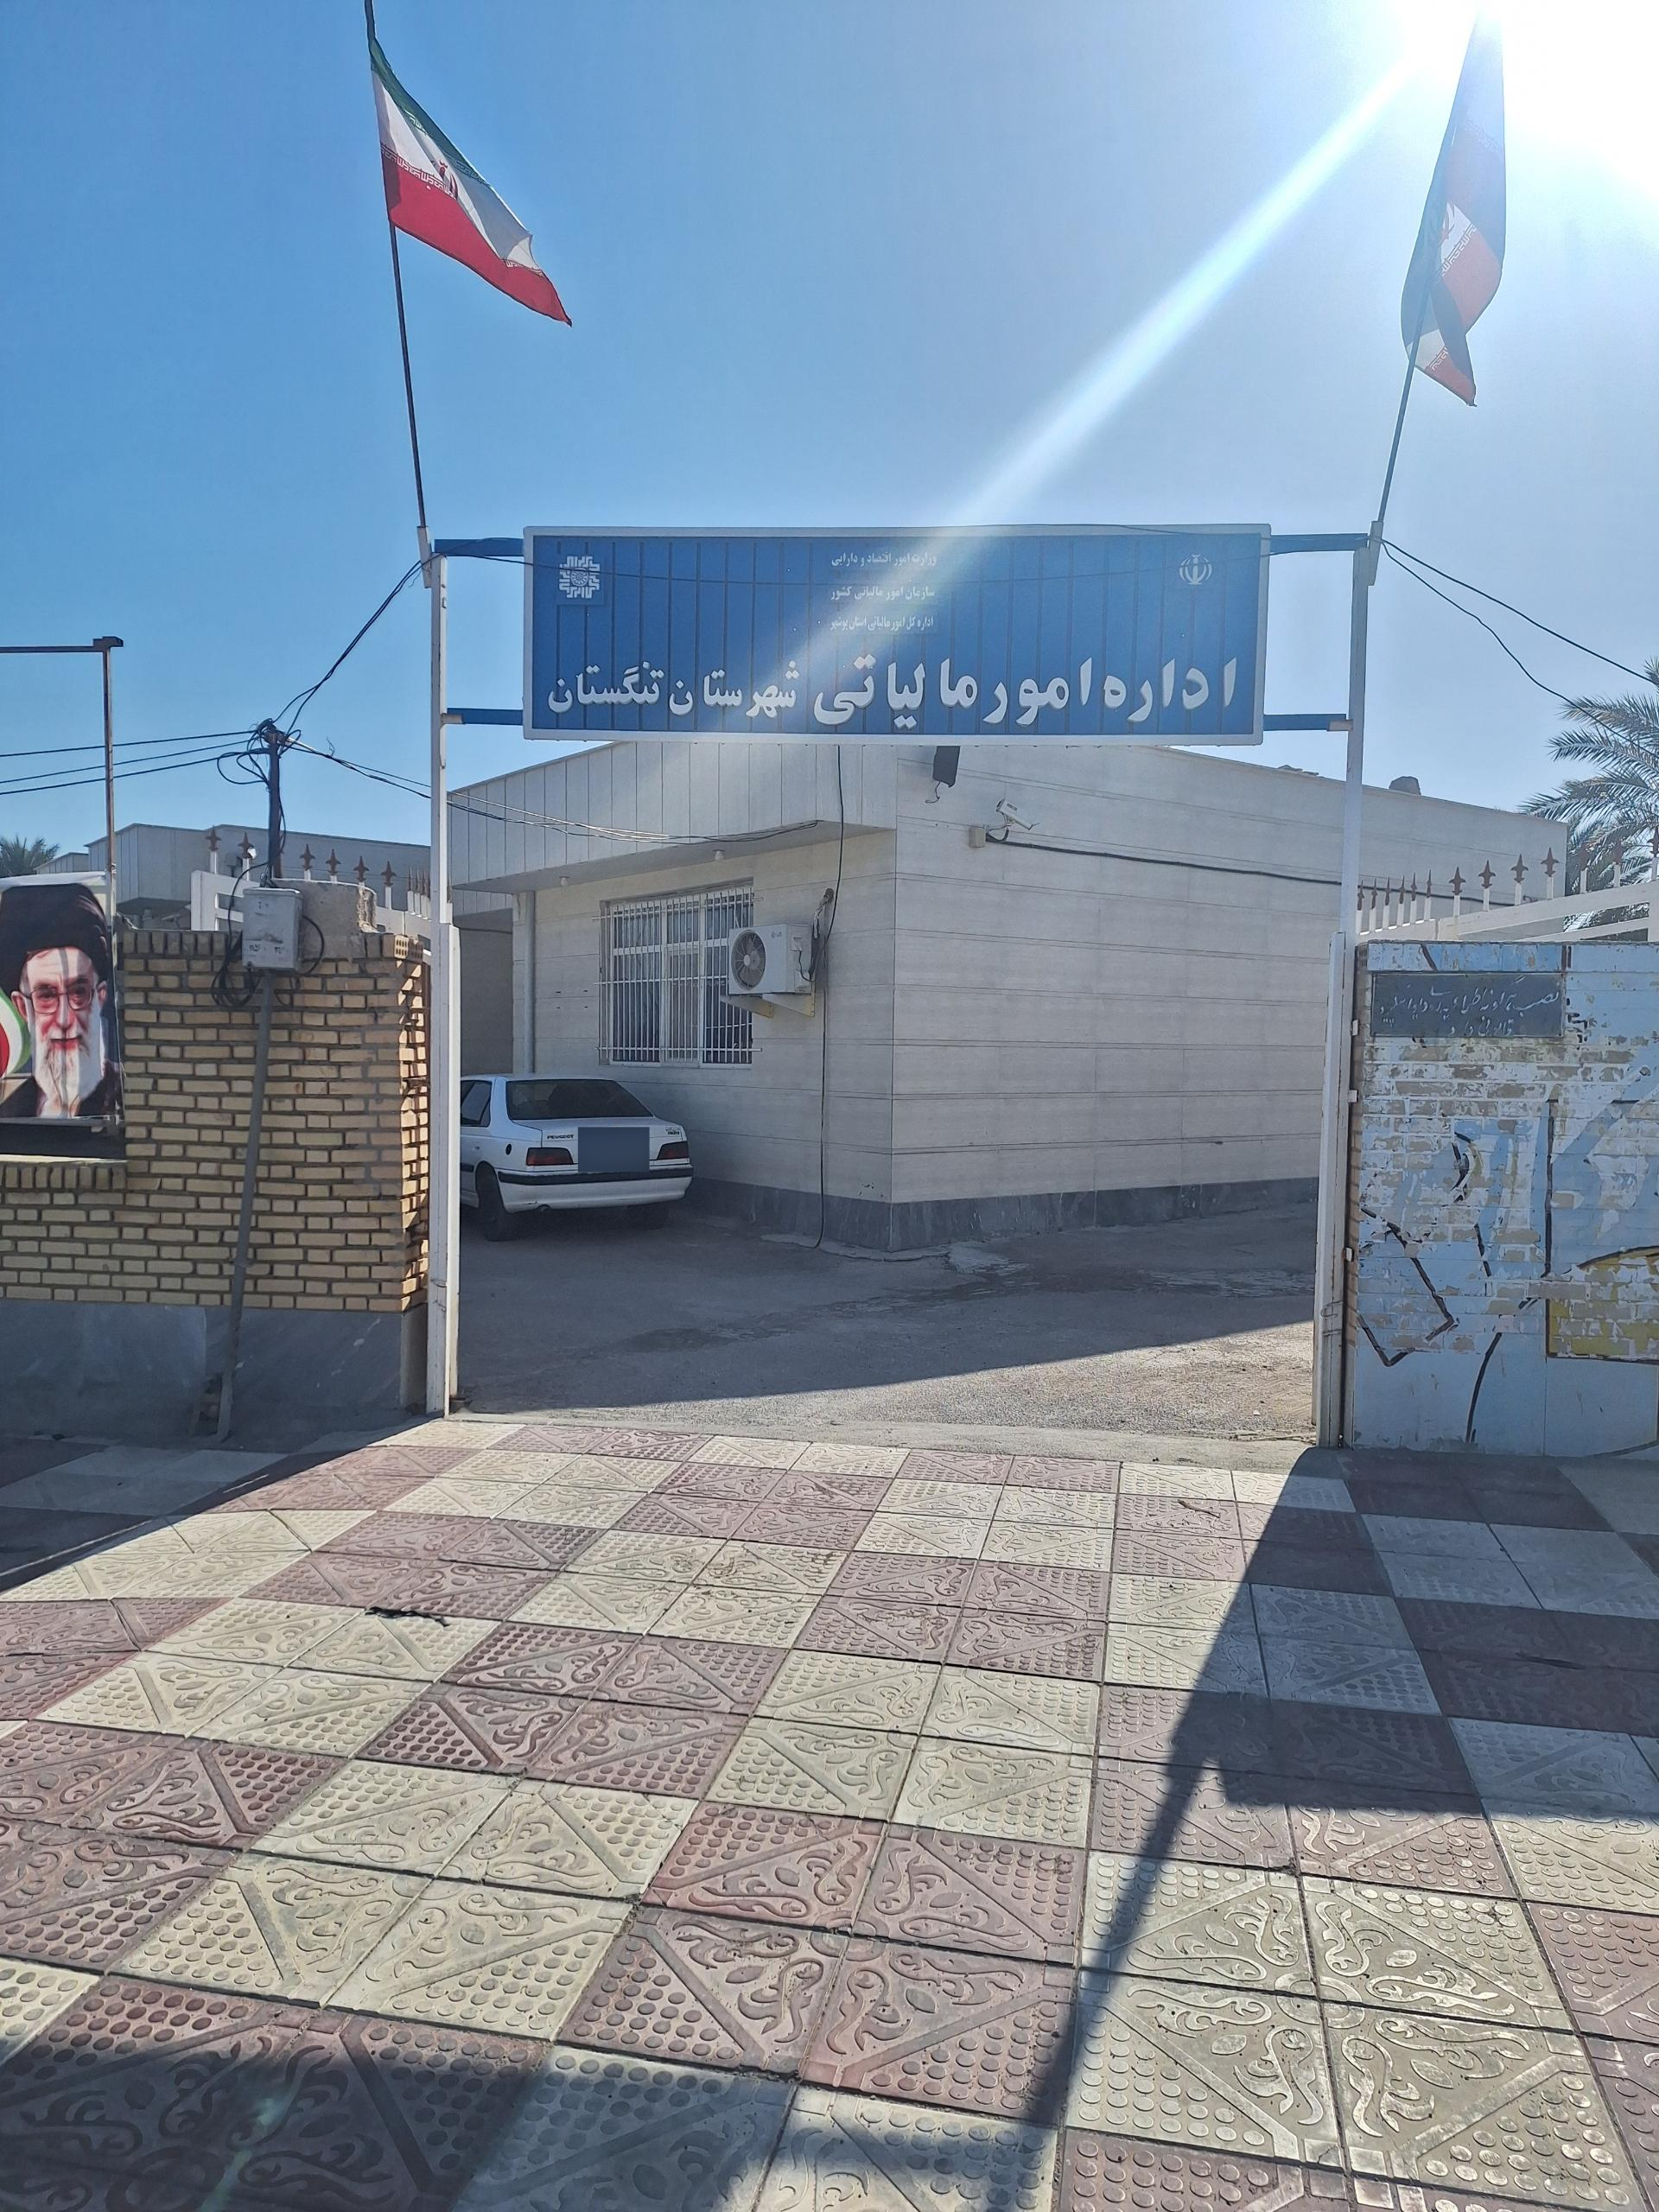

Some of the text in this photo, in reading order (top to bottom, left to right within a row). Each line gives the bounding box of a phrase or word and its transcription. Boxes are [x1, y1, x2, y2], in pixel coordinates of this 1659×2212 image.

[831, 550, 938, 567] وزارت امور اقتصاد و دارایی
[830, 585, 936, 601] سازمان امور مالیاتی کشور
[830, 615, 934, 631] اداره کل امور مالیاتی استان بوشهر
[548, 653, 1238, 730] اداره امور مالیاتی شهرستان تنگستان
